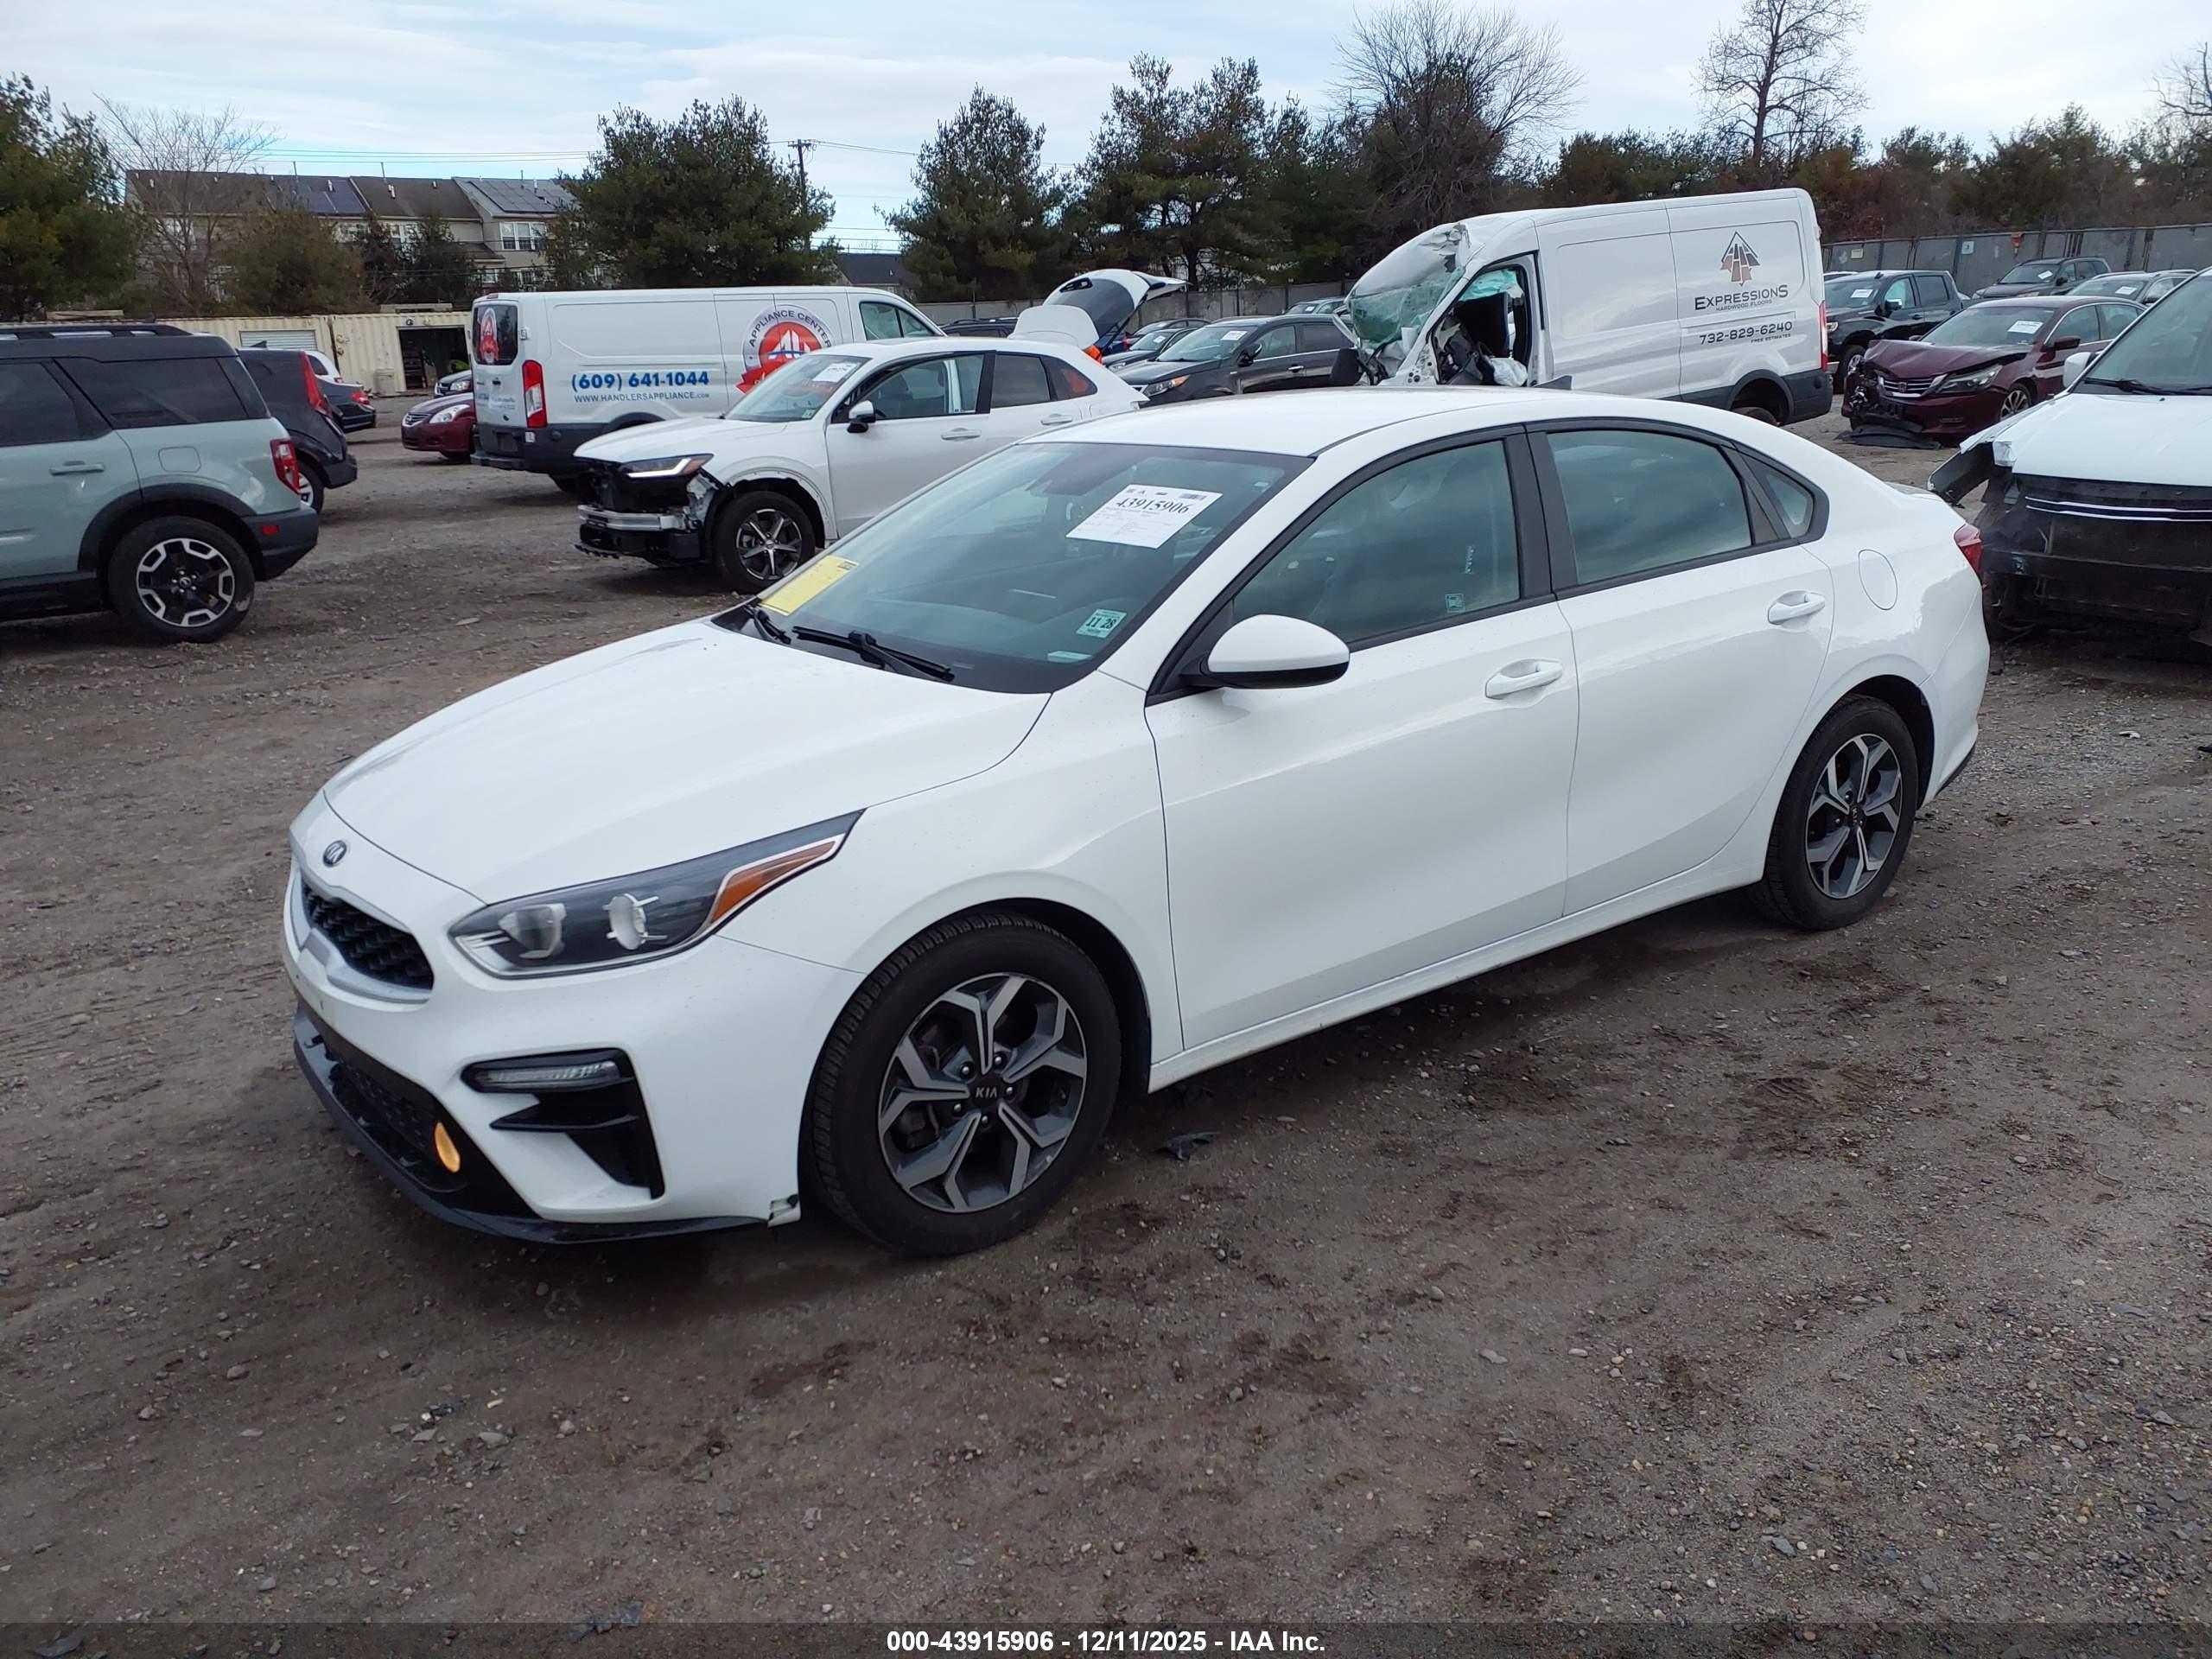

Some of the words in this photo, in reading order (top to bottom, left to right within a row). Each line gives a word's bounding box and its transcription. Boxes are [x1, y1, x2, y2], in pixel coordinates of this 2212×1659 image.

[1715, 302, 1749, 311] HARDWOOD
[748, 309, 796, 347] APPLIANCE
[1699, 321, 1793, 345] 732-829-6240
[571, 373, 622, 392] (609)
[628, 371, 709, 388] 641-1044
[1116, 497, 1194, 514] 43915906
[975, 1087, 997, 1098] KIA
